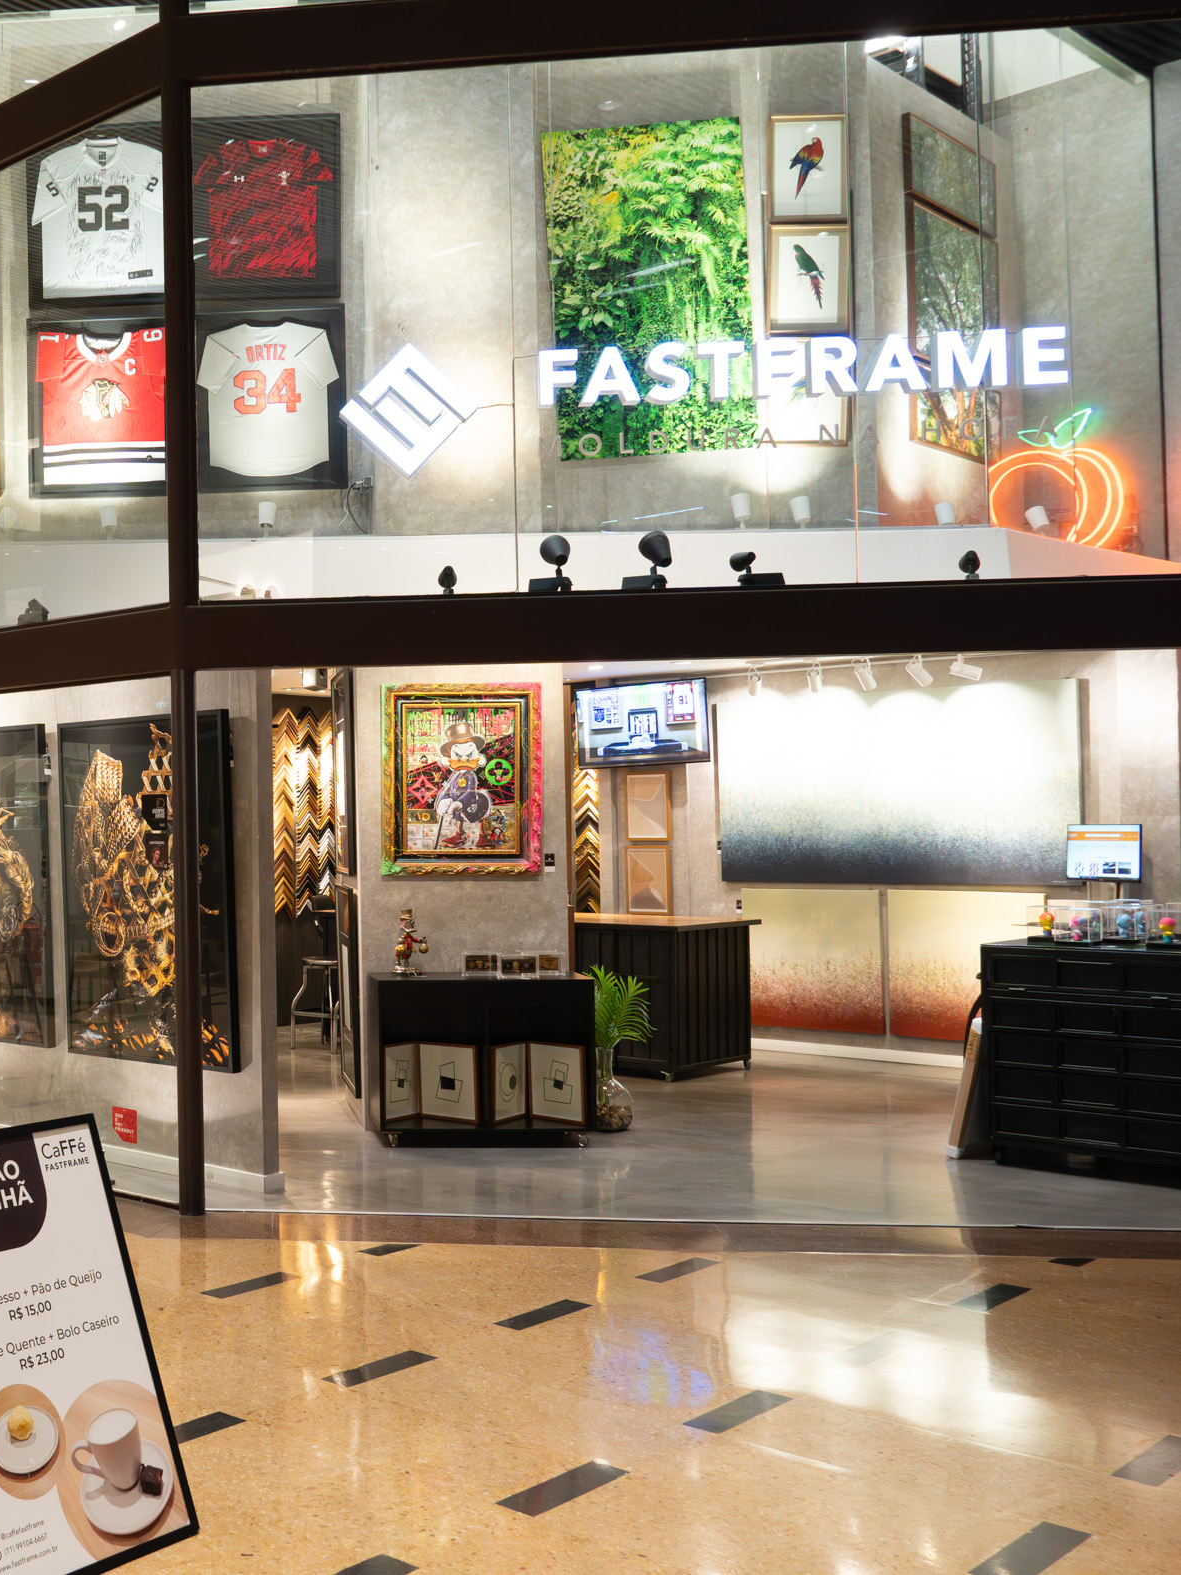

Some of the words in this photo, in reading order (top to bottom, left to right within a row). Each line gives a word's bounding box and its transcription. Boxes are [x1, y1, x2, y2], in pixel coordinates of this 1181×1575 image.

[46, 182, 60, 197] 5
[146, 176, 159, 193] 2
[78, 185, 130, 232] 52
[246, 344, 287, 363] ORTIZ
[125, 358, 137, 376] C
[538, 326, 1070, 410] FASTFRAME
[233, 368, 302, 415] 34
[539, 427, 778, 457] MOLDURA
[819, 420, 880, 446] NA
[921, 415, 1058, 443] HORA
[41, 1137, 86, 1160] CaFFé
[45, 1156, 90, 1172] FASTFRAME
[22, 1288, 29, 1297] +
[31, 1282, 52, 1296] Pão
[53, 1278, 67, 1291] de
[69, 1269, 102, 1287] Queijo
[8, 1307, 24, 1321] R$
[25, 1300, 52, 1317] 15,00
[6, 1334, 46, 1355] Quente
[48, 1333, 55, 1341] +
[57, 1325, 81, 1340] Bolo
[82, 1314, 120, 1333] Caseiro
[19, 1355, 35, 1370] R$
[36, 1347, 65, 1364] 23,00
[3, 1545, 16, 1556] (11)
